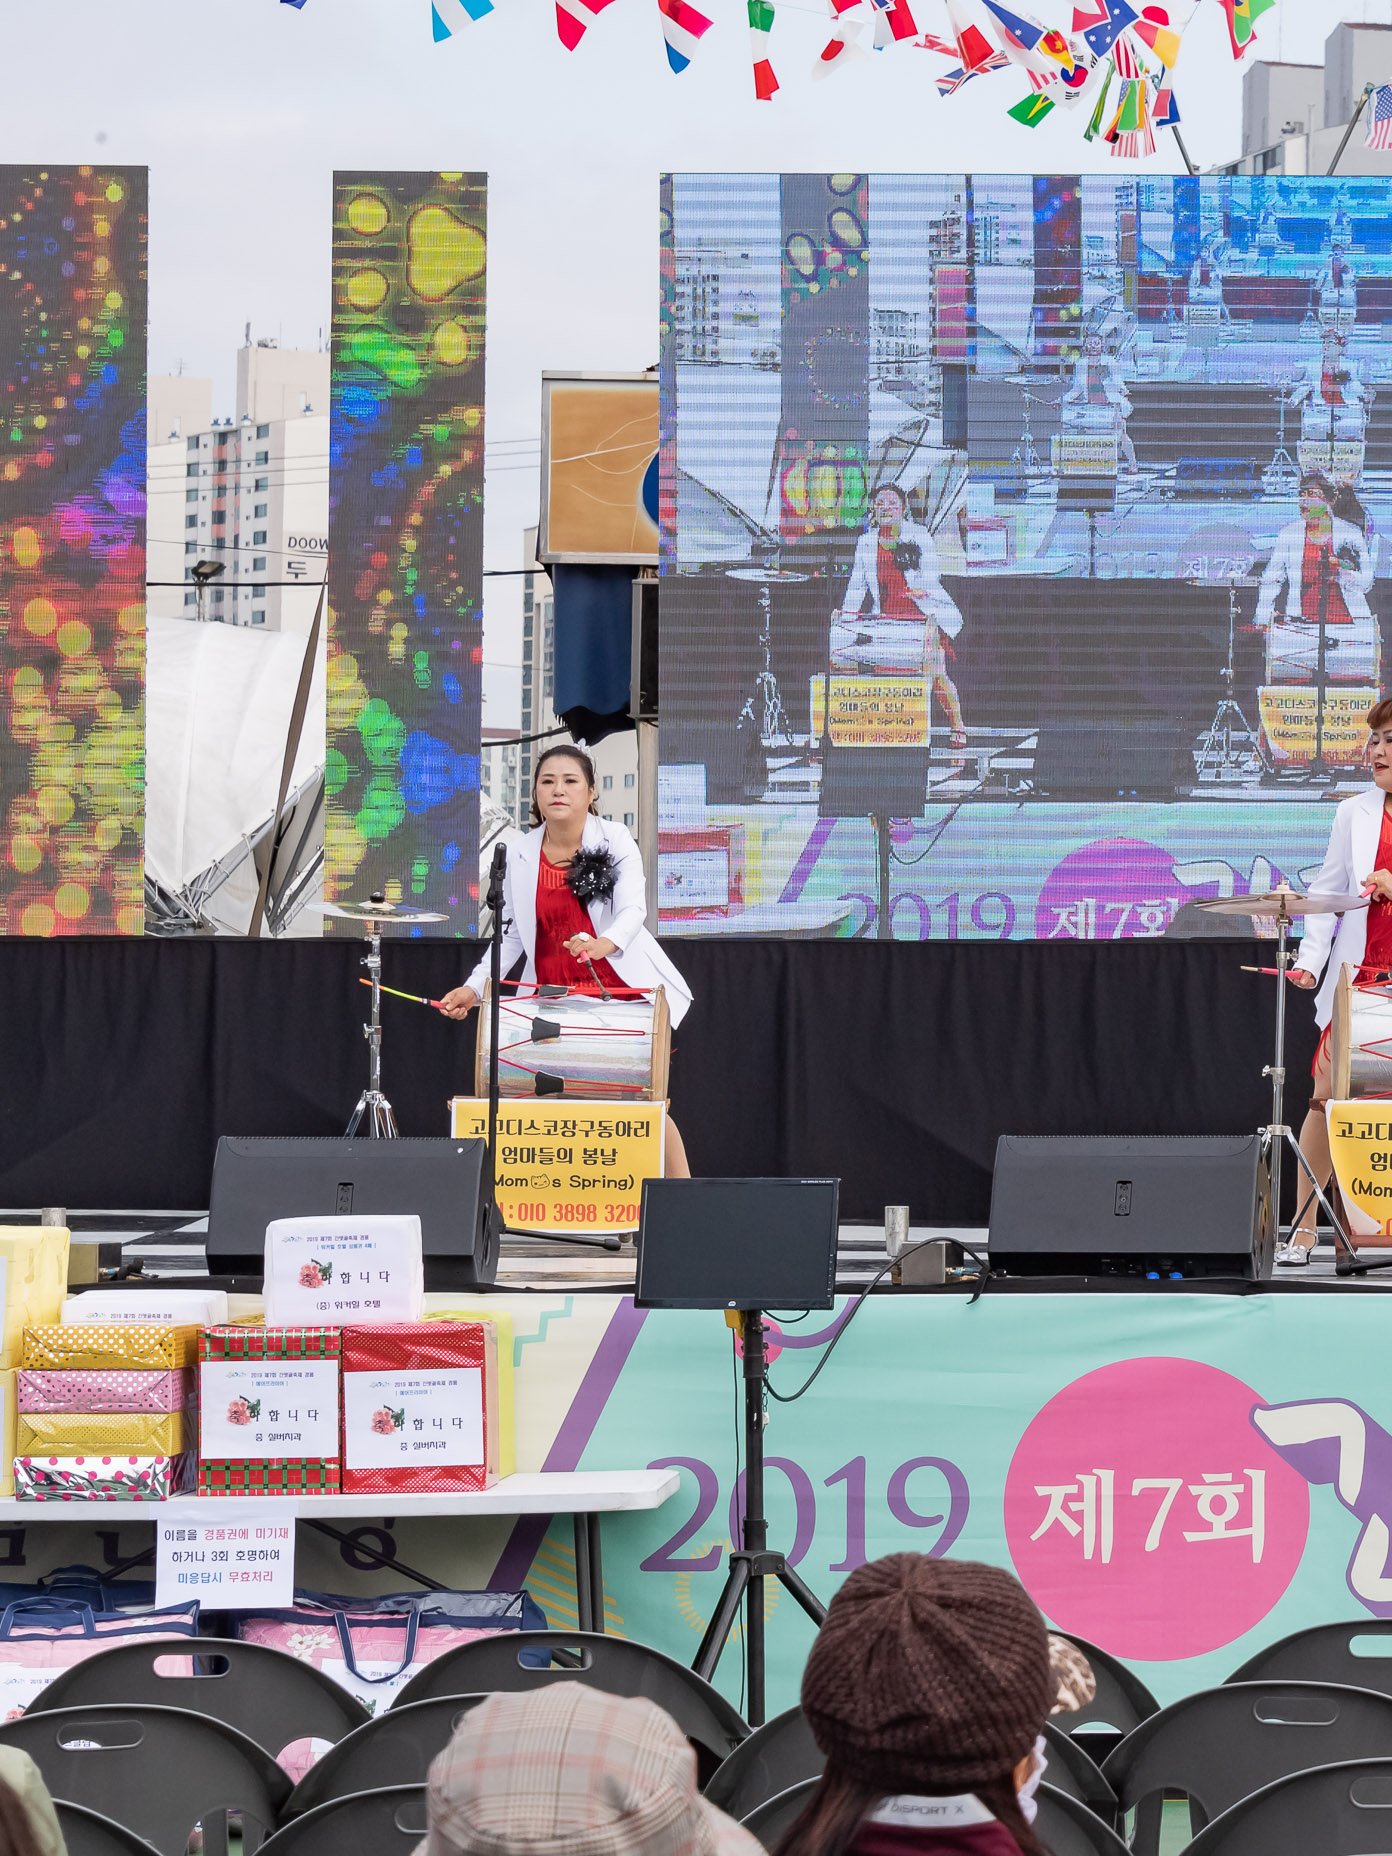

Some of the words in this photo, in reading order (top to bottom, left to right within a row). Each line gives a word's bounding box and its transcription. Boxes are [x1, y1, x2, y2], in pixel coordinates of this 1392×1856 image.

[286, 561, 307, 579] 두
[501, 1146, 573, 1165] 엄마들의
[581, 1147, 619, 1166] 봄날
[569, 1174, 635, 1191] Spring)
[553, 1202, 597, 1223] 3898
[604, 1203, 641, 1223] 320
[640, 1455, 970, 1573] 2019
[1030, 1467, 1267, 1565] 제7회
[164, 1528, 198, 1542] 이름을
[204, 1528, 249, 1541] 경품권에
[255, 1527, 289, 1540] 미기재
[172, 1551, 205, 1563] 하거나
[211, 1550, 229, 1562] 3회
[236, 1549, 280, 1561] 호명하여
[177, 1571, 222, 1584] 미응답시
[228, 1570, 273, 1583] 무효처리
